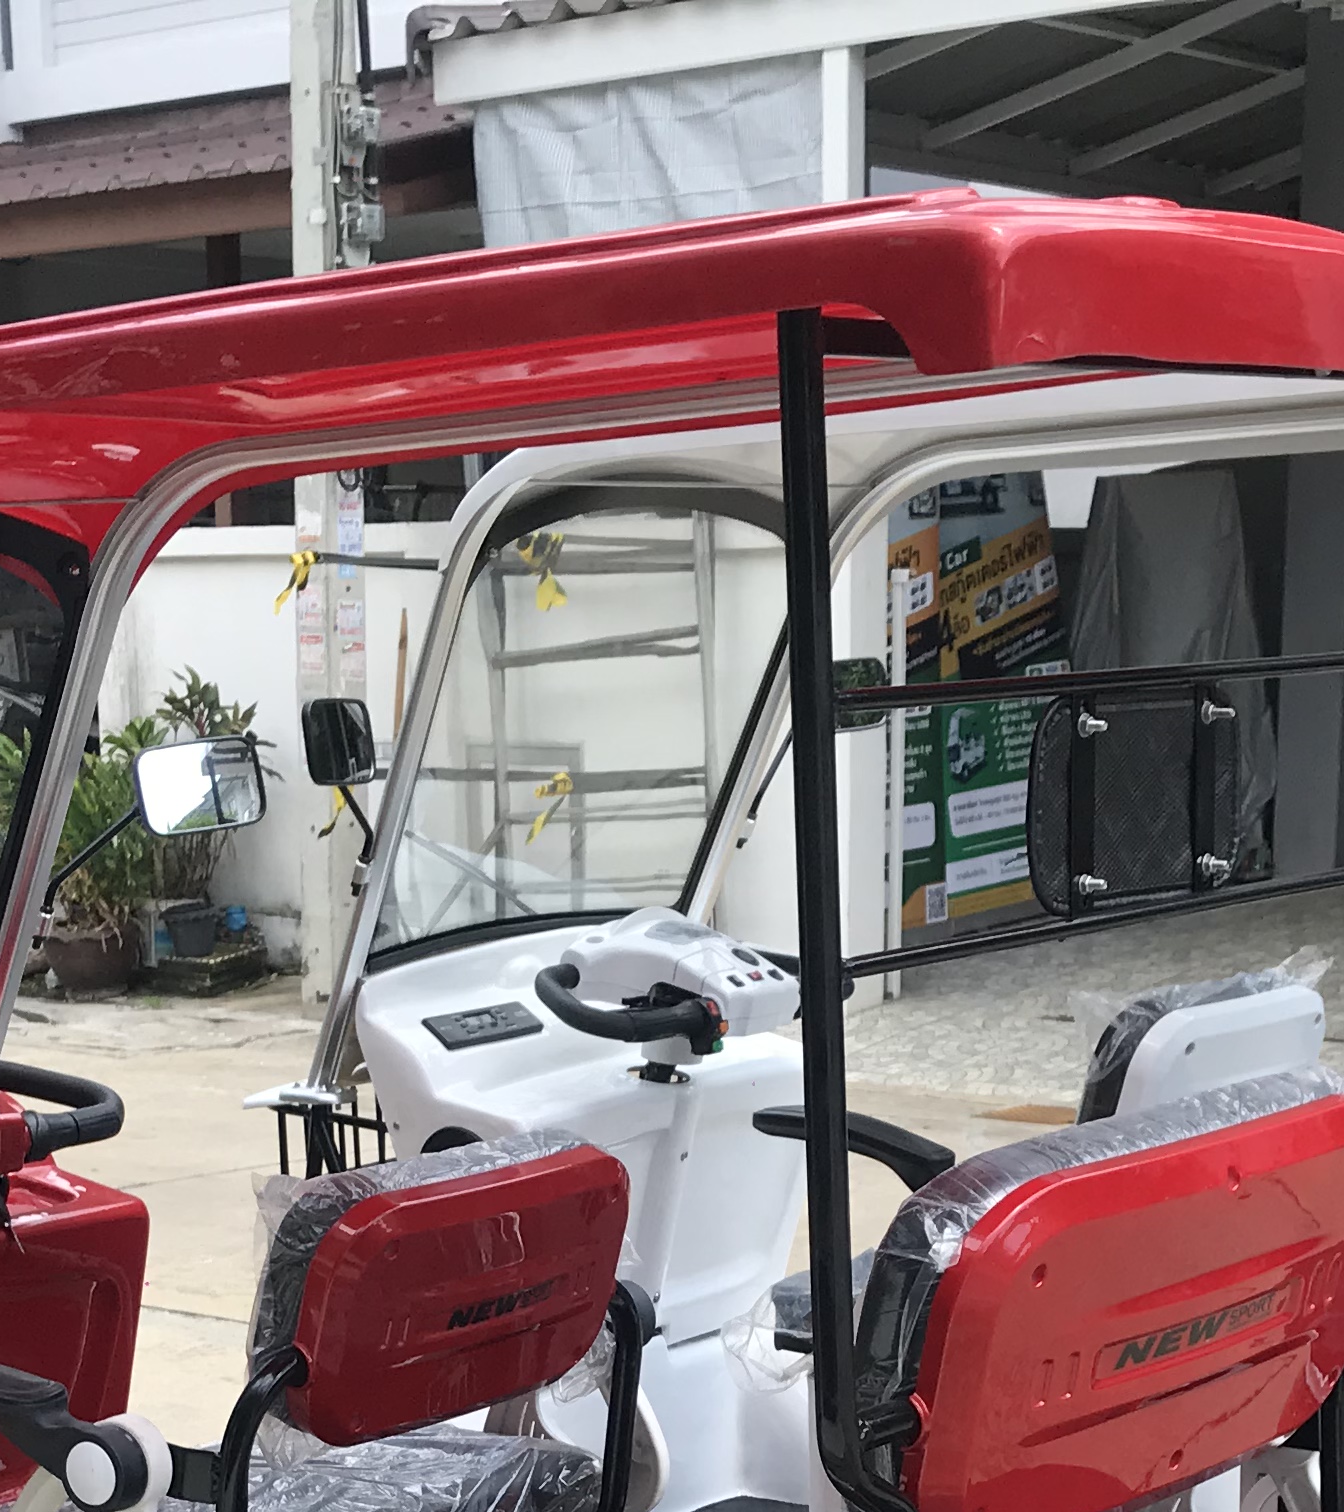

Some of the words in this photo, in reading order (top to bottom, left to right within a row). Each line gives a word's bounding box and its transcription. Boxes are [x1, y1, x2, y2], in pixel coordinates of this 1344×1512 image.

[945, 548, 969, 570] Car
[448, 1294, 519, 1329] NEW
[1114, 1311, 1229, 1369] NEW
[1228, 1293, 1277, 1324] SPORT
